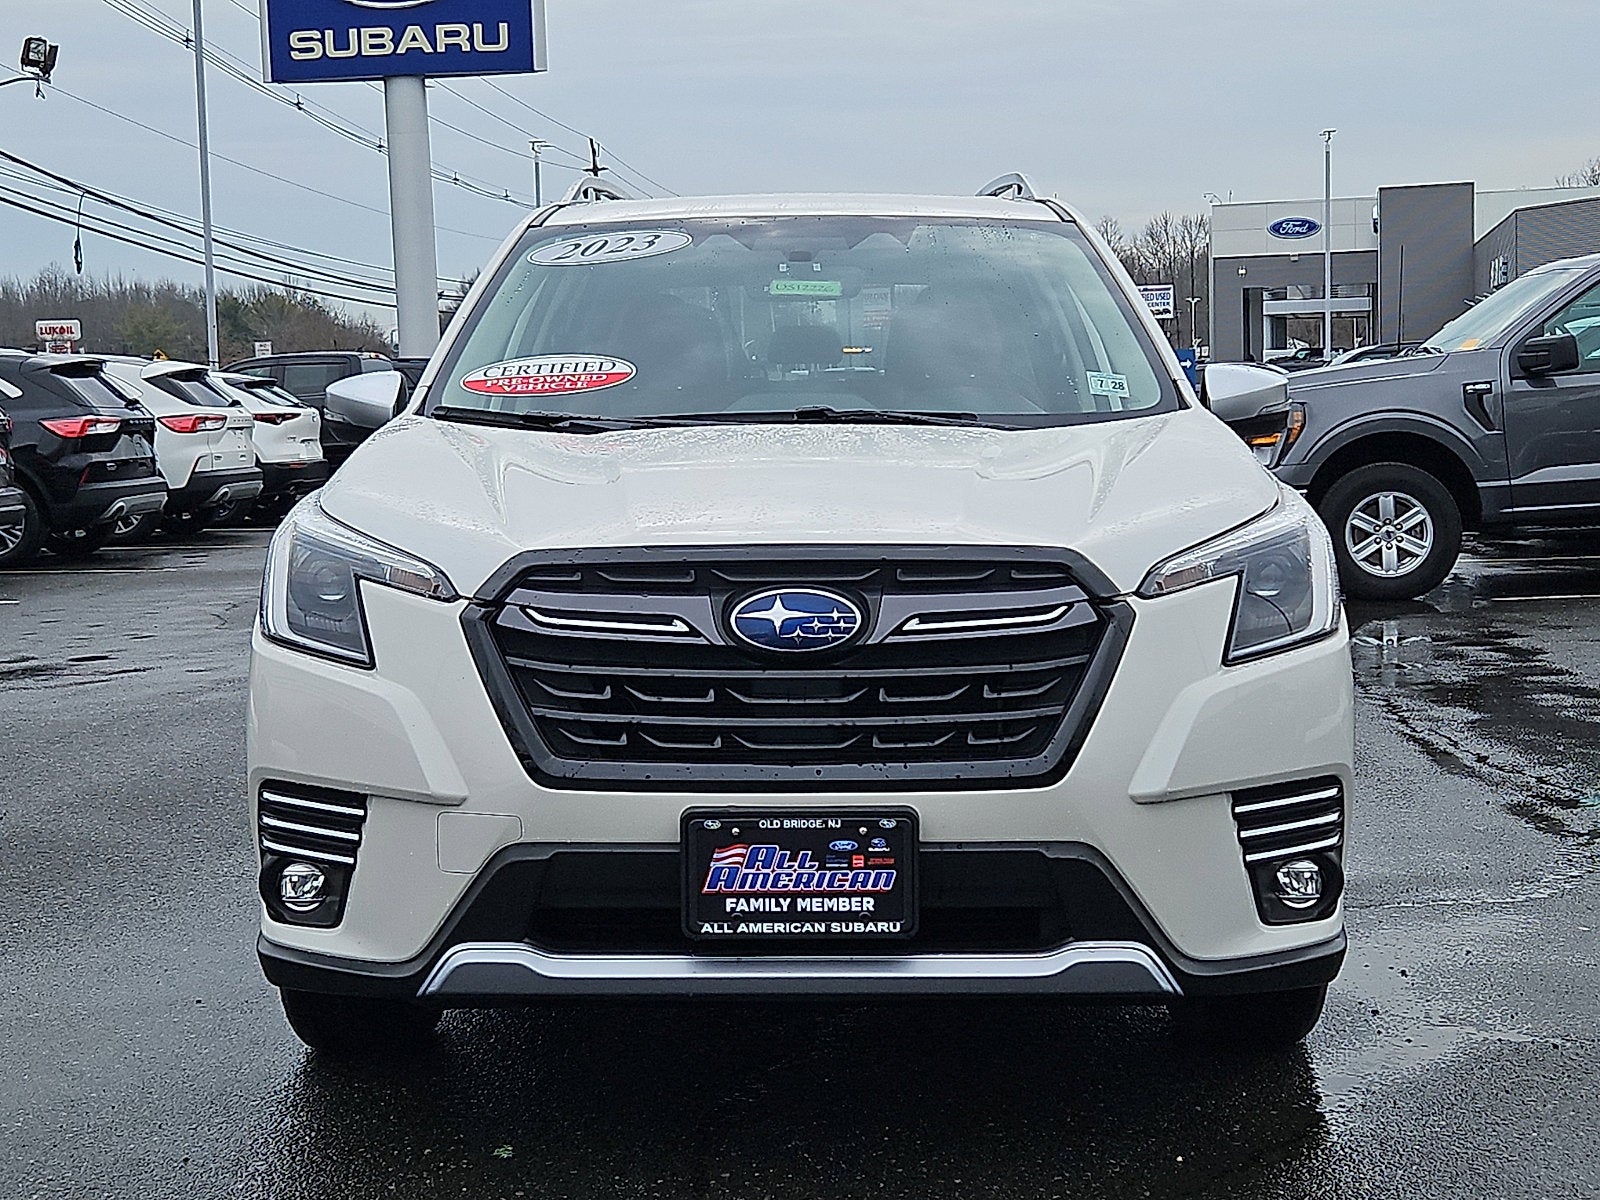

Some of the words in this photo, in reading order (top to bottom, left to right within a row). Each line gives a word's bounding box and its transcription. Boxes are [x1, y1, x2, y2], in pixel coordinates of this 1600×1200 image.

[289, 22, 508, 60] SUBARU
[1280, 221, 1309, 234] Ford
[551, 234, 662, 261] 2023
[1155, 292, 1171, 301] USED
[40, 325, 75, 336] LUKOIL
[483, 361, 617, 379] CERTIFIED
[484, 374, 608, 388] PRE-OWNED
[501, 381, 588, 393] VEHICLE
[1097, 379, 1104, 388] 7
[1110, 381, 1125, 391] 28
[758, 819, 780, 829] OLD
[828, 819, 842, 829] NJ
[725, 898, 792, 912] FAMILY
[797, 898, 875, 912] MEMBER
[701, 923, 734, 934] ALL
[737, 923, 826, 934] AMERICAN
[830, 922, 901, 934] SUBARU
